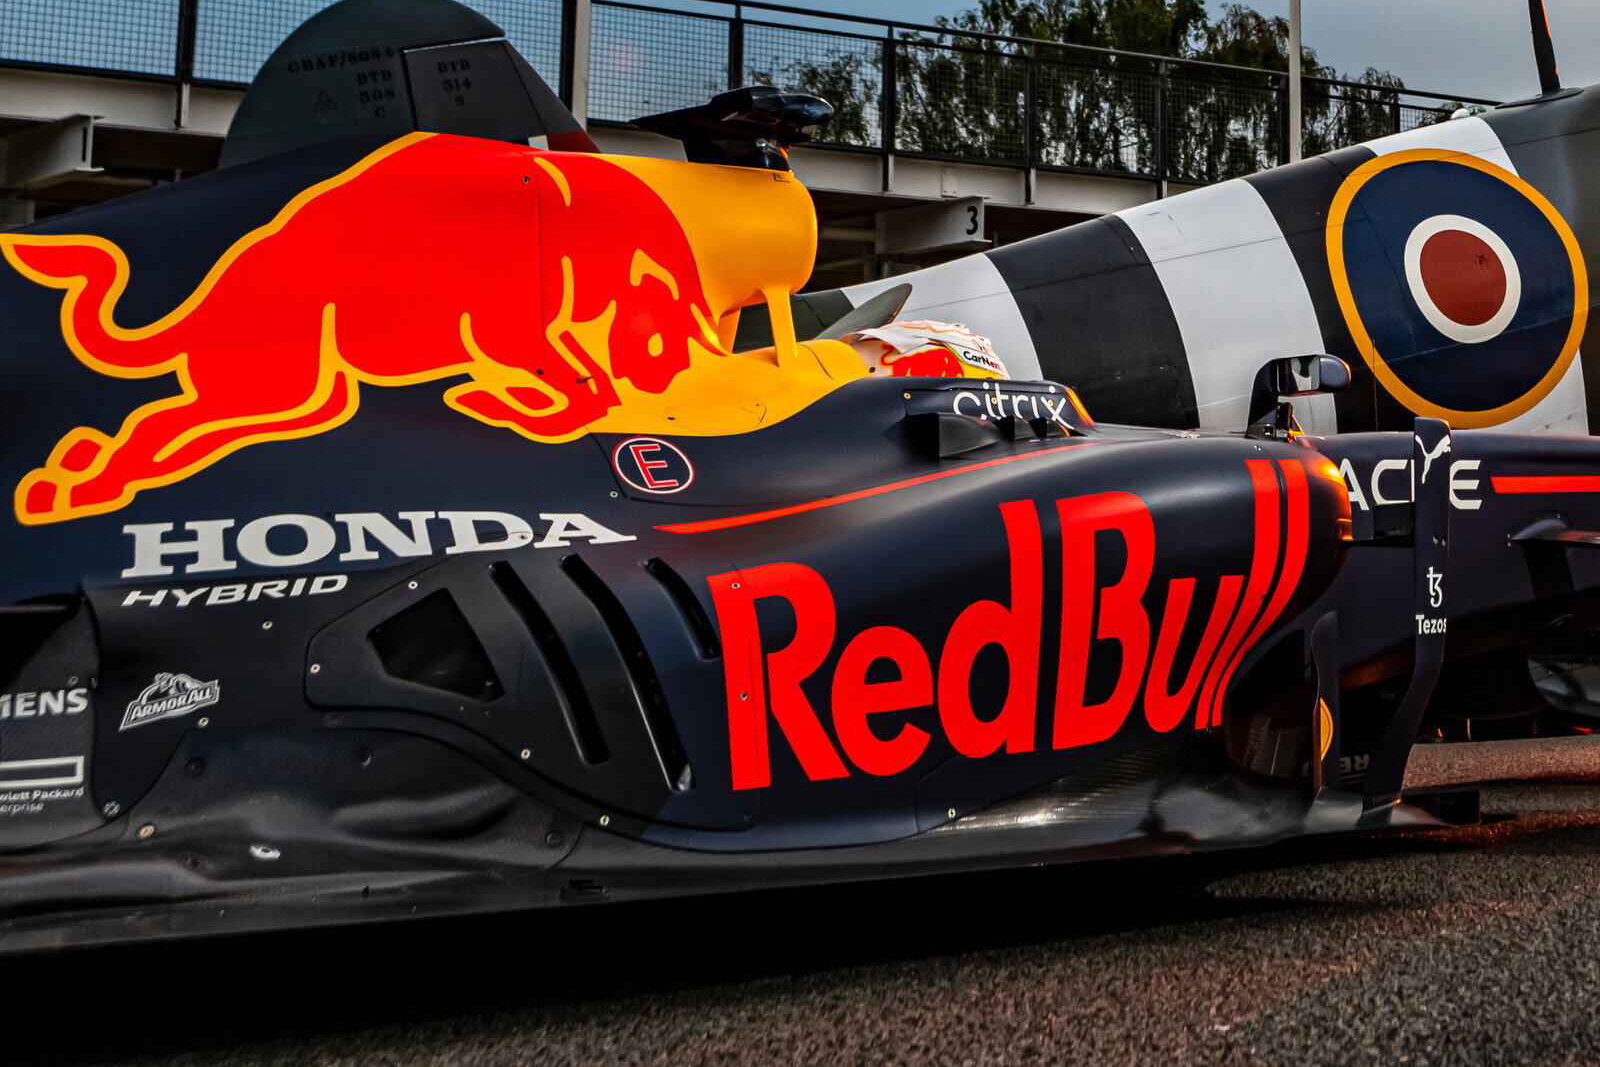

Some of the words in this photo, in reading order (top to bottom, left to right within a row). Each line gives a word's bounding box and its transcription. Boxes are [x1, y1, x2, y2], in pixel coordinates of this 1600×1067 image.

[966, 205, 978, 235] 3
[631, 444, 678, 489] E
[1339, 458, 1482, 511] ACE
[121, 511, 637, 578] HONDA
[121, 575, 348, 607] HYBRID
[1415, 614, 1447, 635] Tezos
[32, 787, 84, 801] Packard
